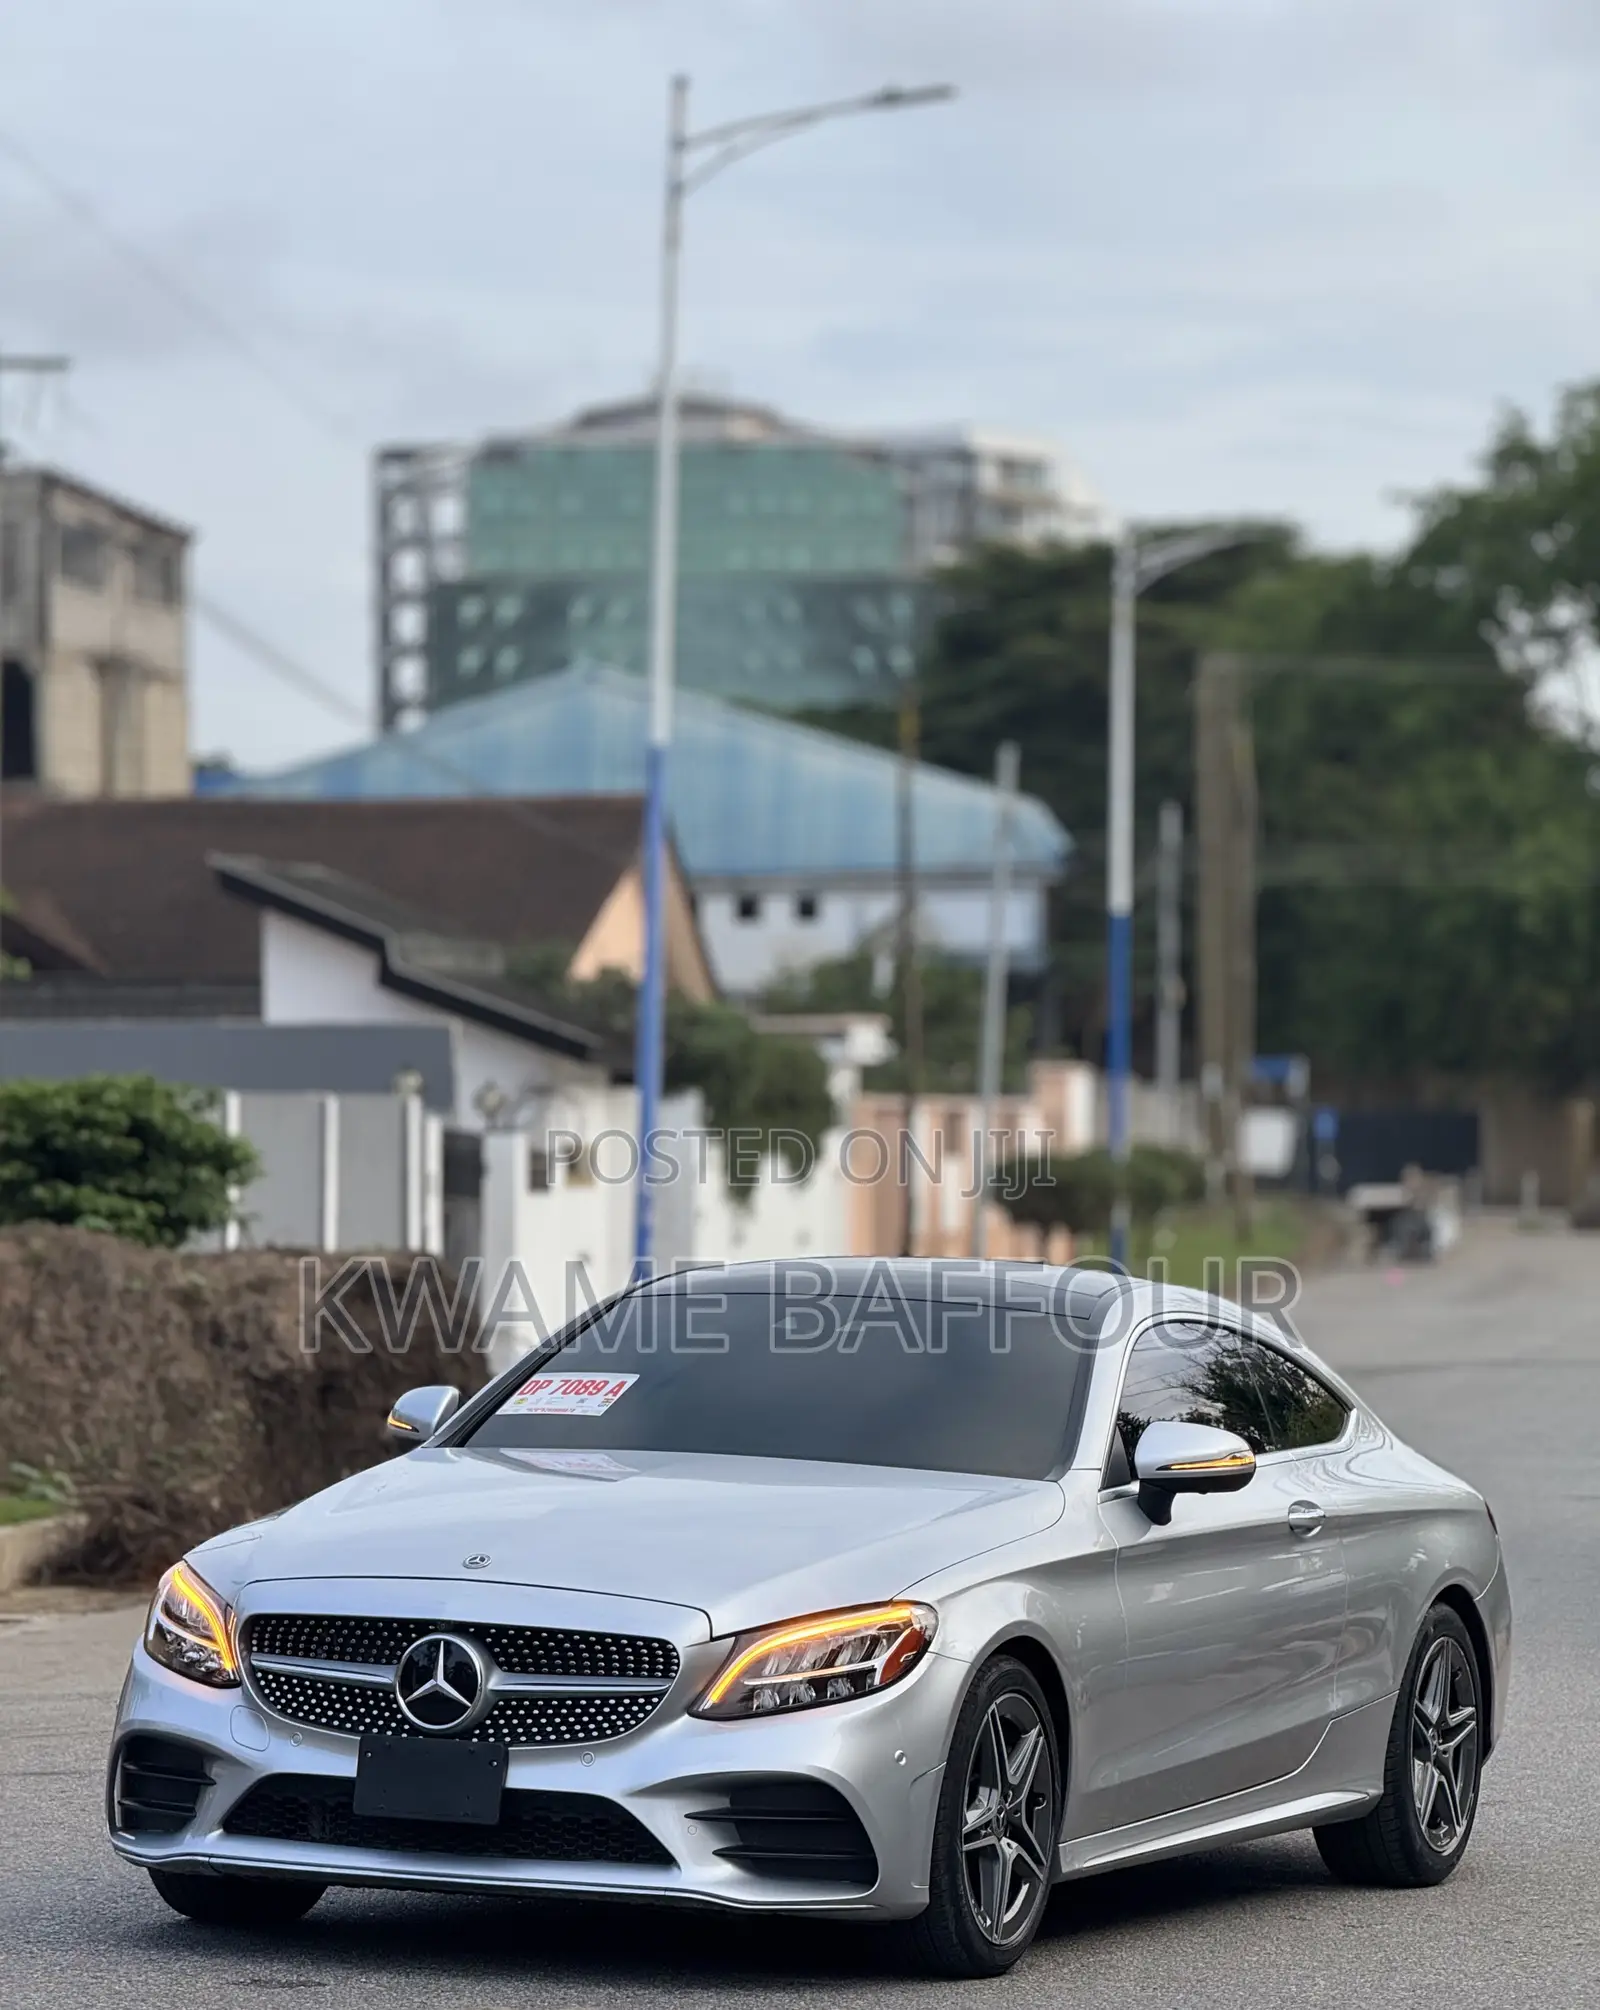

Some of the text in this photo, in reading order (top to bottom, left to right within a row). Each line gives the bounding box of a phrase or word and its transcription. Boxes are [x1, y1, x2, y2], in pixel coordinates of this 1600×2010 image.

[518, 1379, 628, 1397] DP 7089 A
